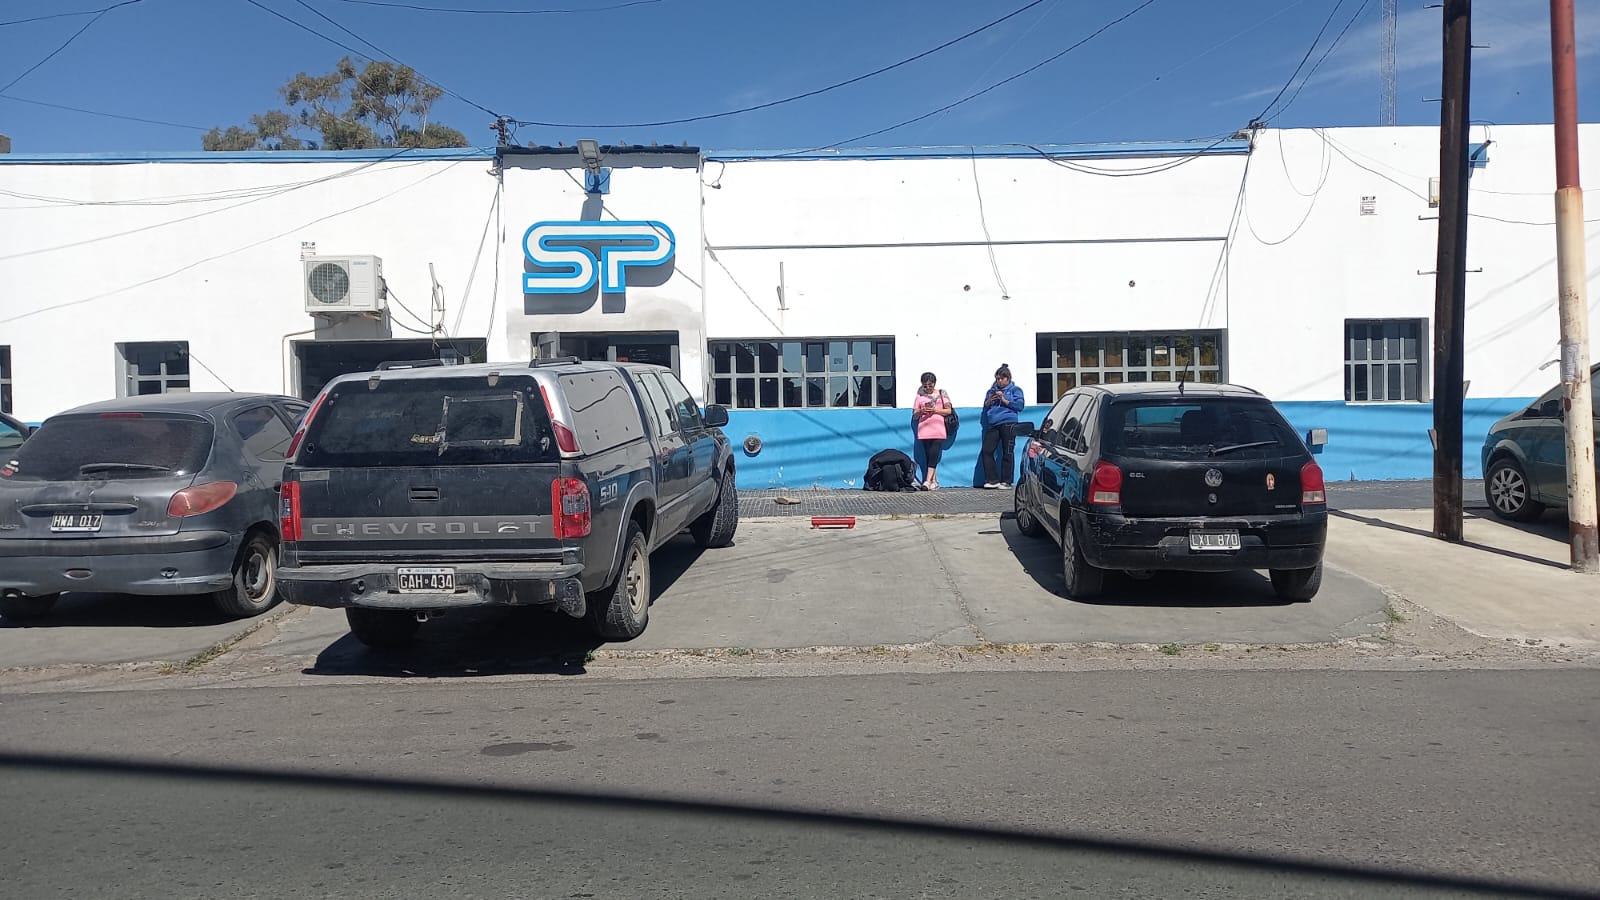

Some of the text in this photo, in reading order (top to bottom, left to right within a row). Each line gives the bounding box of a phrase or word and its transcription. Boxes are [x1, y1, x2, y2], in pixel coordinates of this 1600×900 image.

[522, 220, 675, 294] SP
[53, 515, 101, 527] HWA 017
[311, 521, 541, 535] CHEVROLET
[1192, 534, 1212, 545] LXI
[400, 574, 423, 589] GAH
[430, 574, 453, 589] 434
